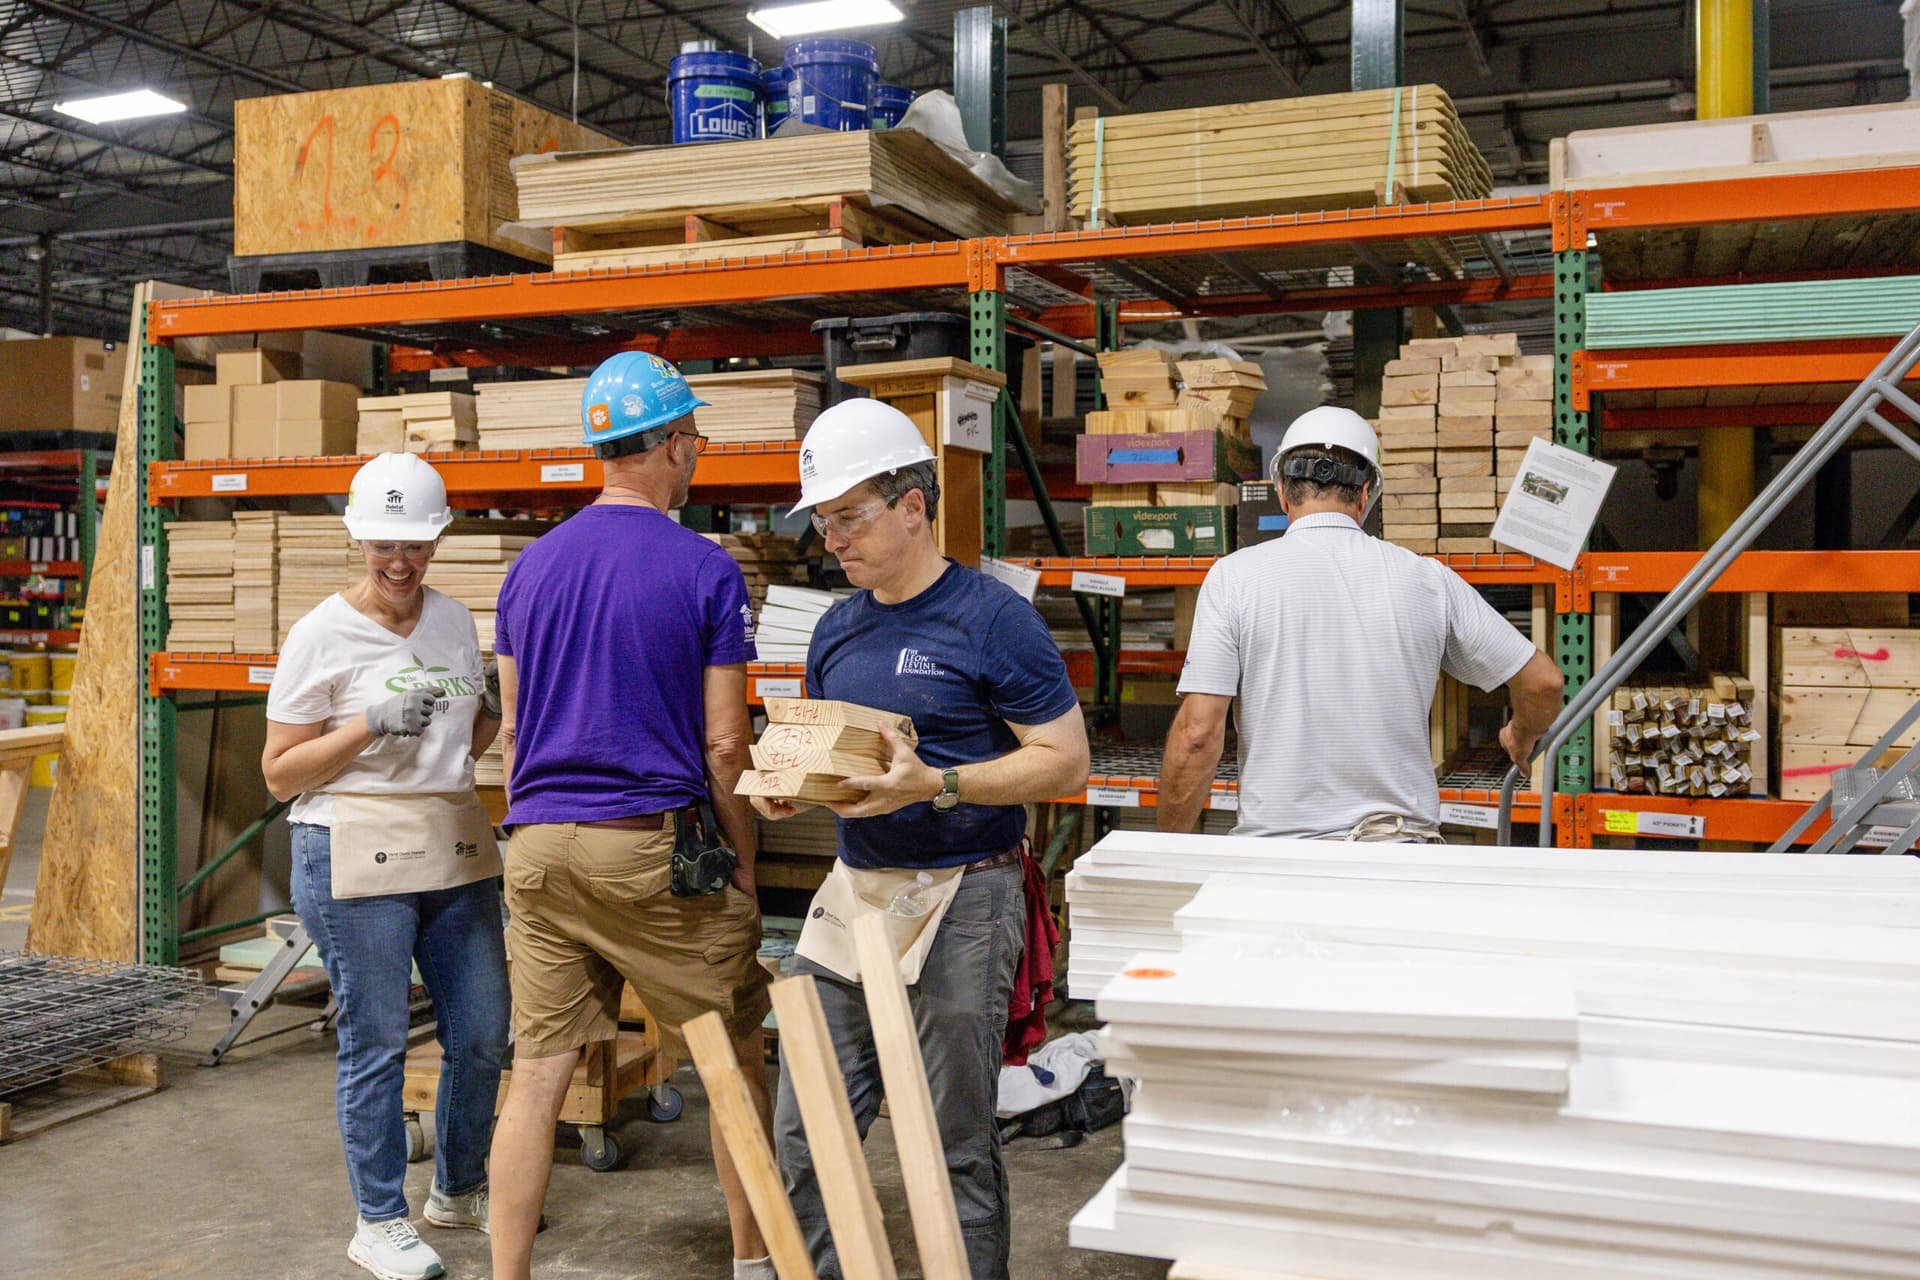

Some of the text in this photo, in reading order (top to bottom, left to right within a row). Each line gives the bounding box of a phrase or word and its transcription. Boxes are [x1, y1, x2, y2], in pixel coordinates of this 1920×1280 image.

[698, 114, 754, 138] LOWE'S
[1133, 510, 1178, 521] videxport
[905, 654, 929, 662] LEON
[902, 668, 945, 676] FOUNDATION
[904, 661, 936, 671] LEVINE
[784, 728, 812, 745] 7-12
[769, 753, 800, 768] 7-12
[759, 774, 781, 788] 7-12
